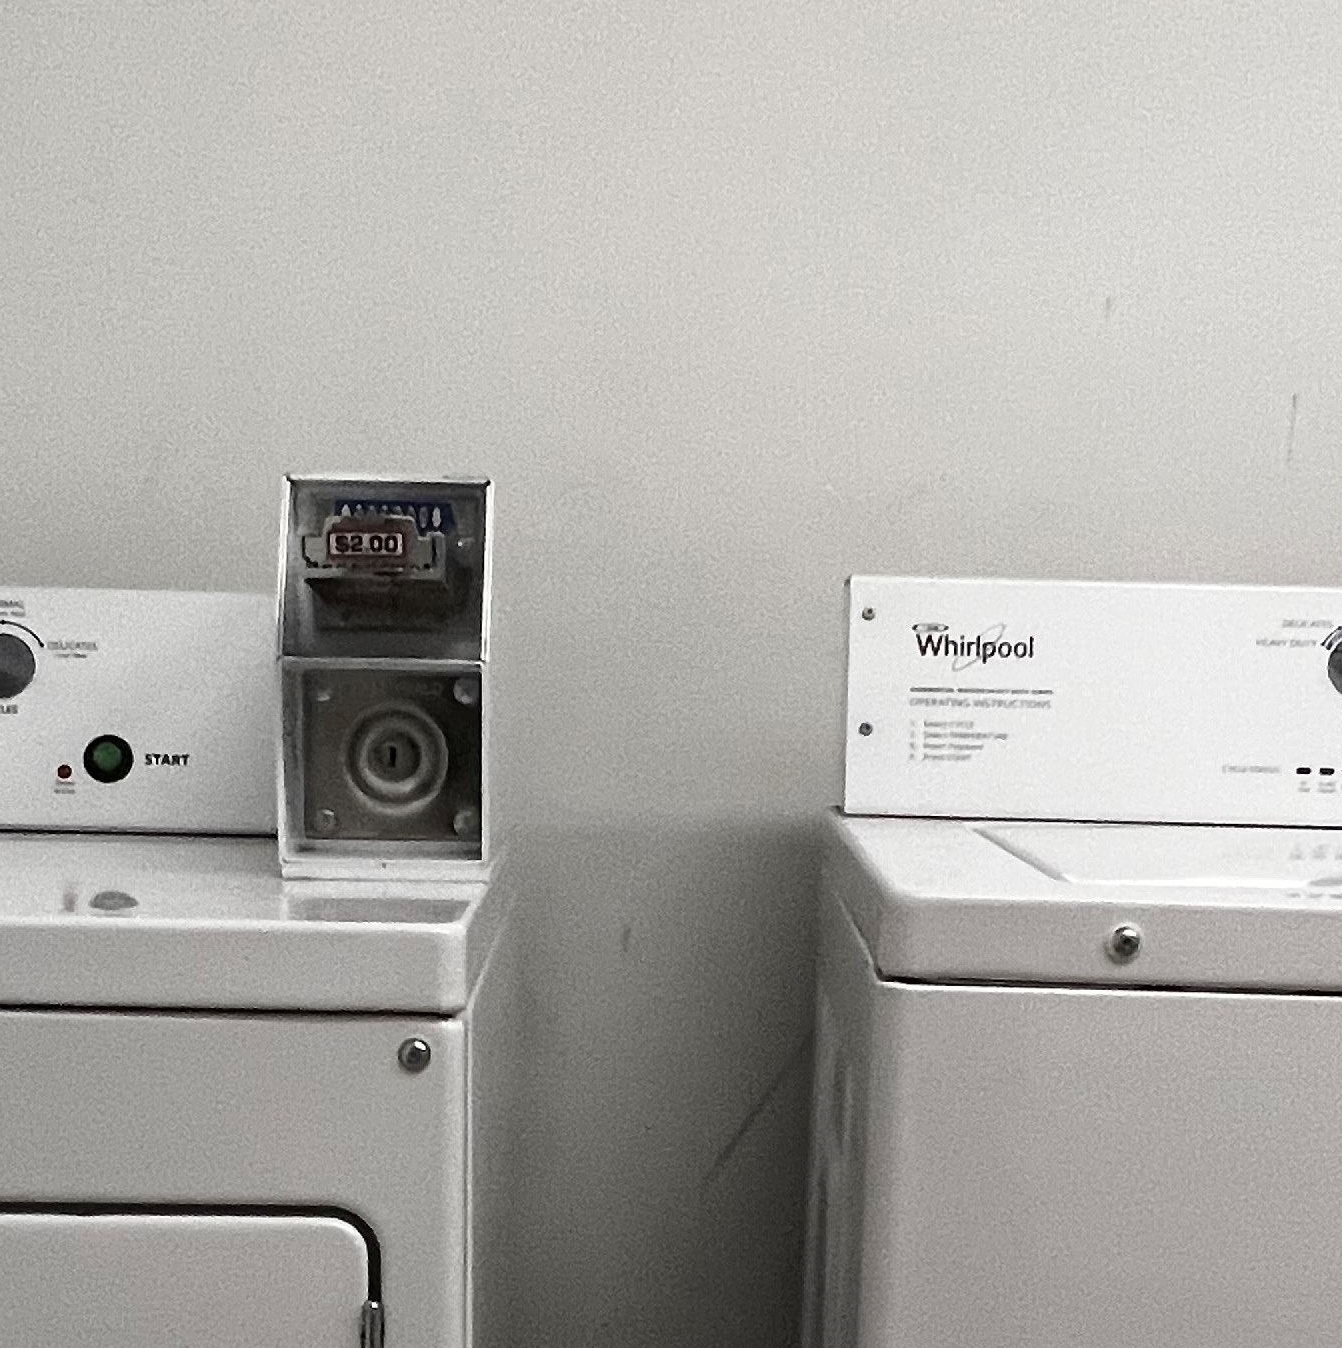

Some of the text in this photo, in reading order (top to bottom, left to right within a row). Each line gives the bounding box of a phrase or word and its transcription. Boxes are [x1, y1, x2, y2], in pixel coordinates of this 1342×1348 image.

[334, 534, 399, 553] $2.00
[915, 633, 1035, 664] Whirlpool
[144, 753, 190, 766] START
